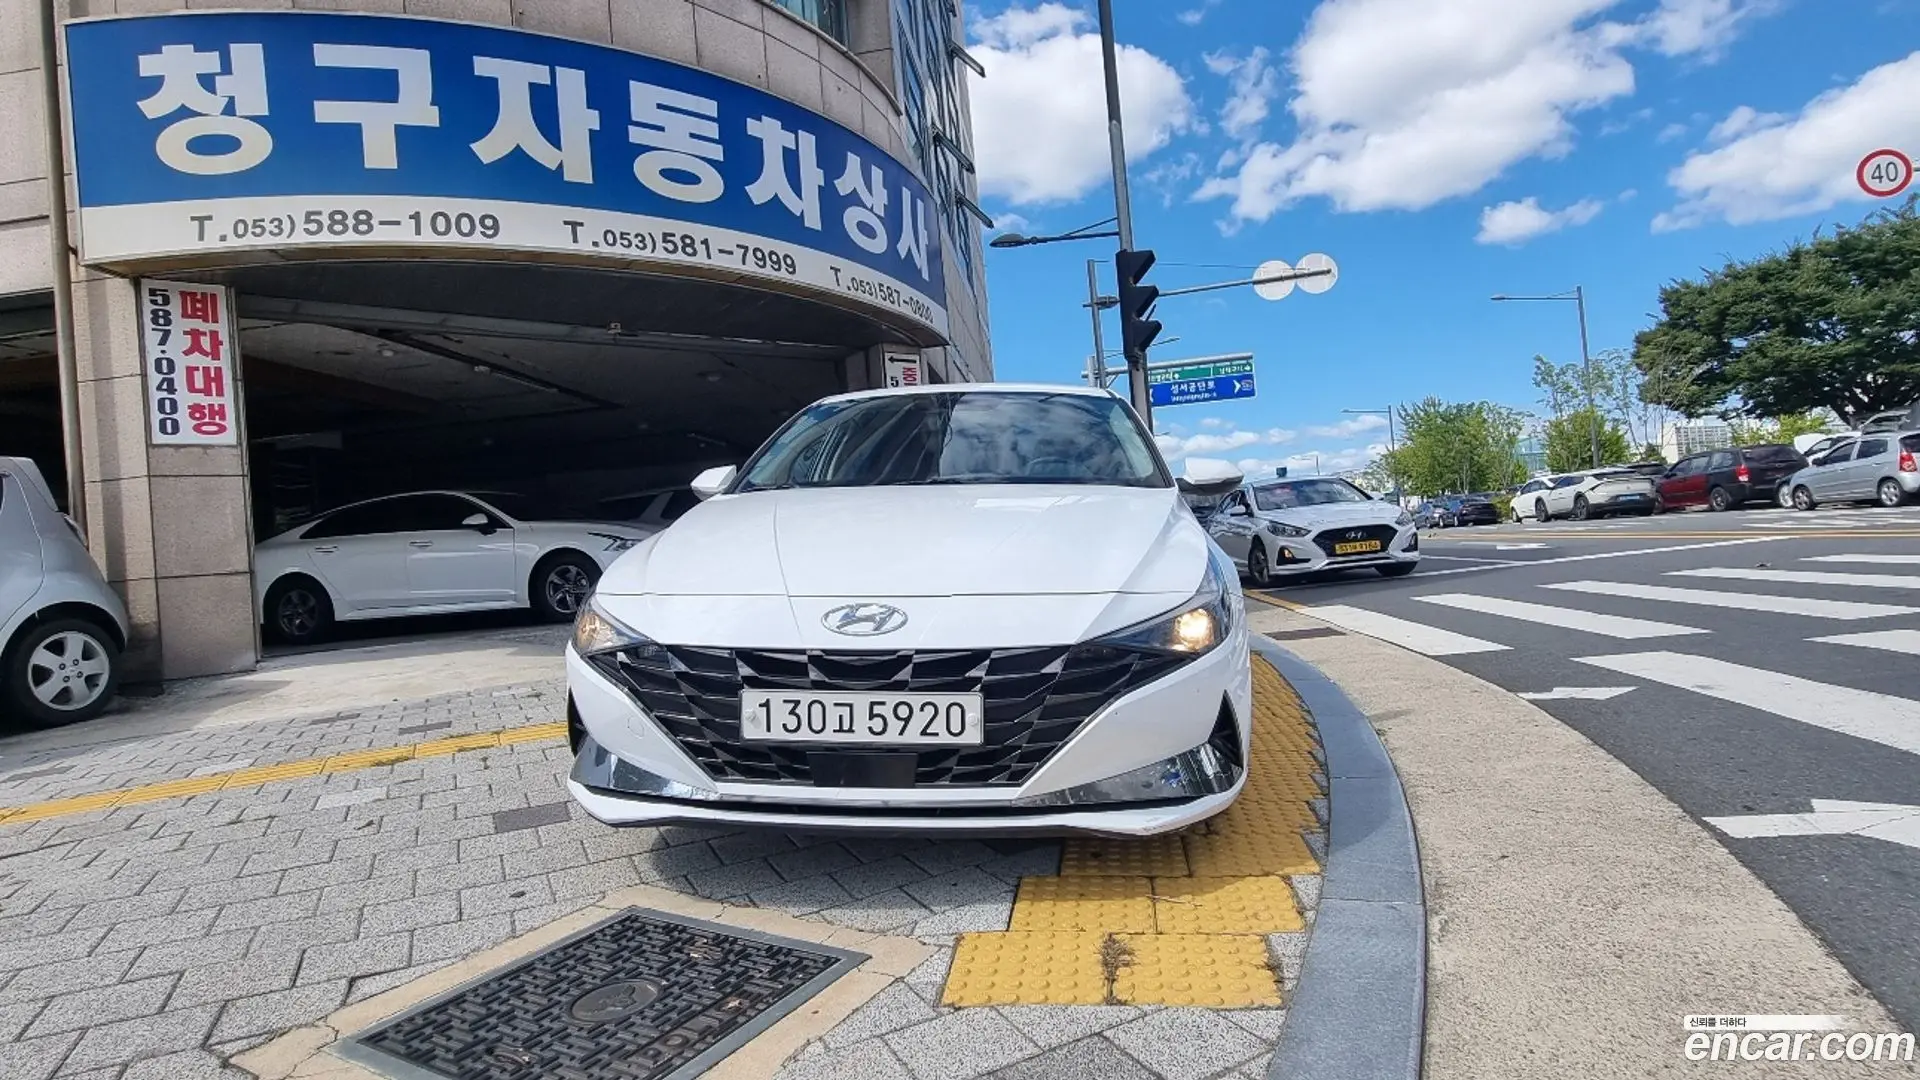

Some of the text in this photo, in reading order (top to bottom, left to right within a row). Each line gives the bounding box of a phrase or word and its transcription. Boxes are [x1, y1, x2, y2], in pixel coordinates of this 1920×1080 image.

[136, 43, 930, 281] 청구자동차상사
[1871, 161, 1899, 184] 40
[178, 290, 228, 436] 폐차대행
[902, 367, 918, 386] 중
[1170, 380, 1216, 394] 성서공단로
[758, 698, 966, 737] 130고 5920
